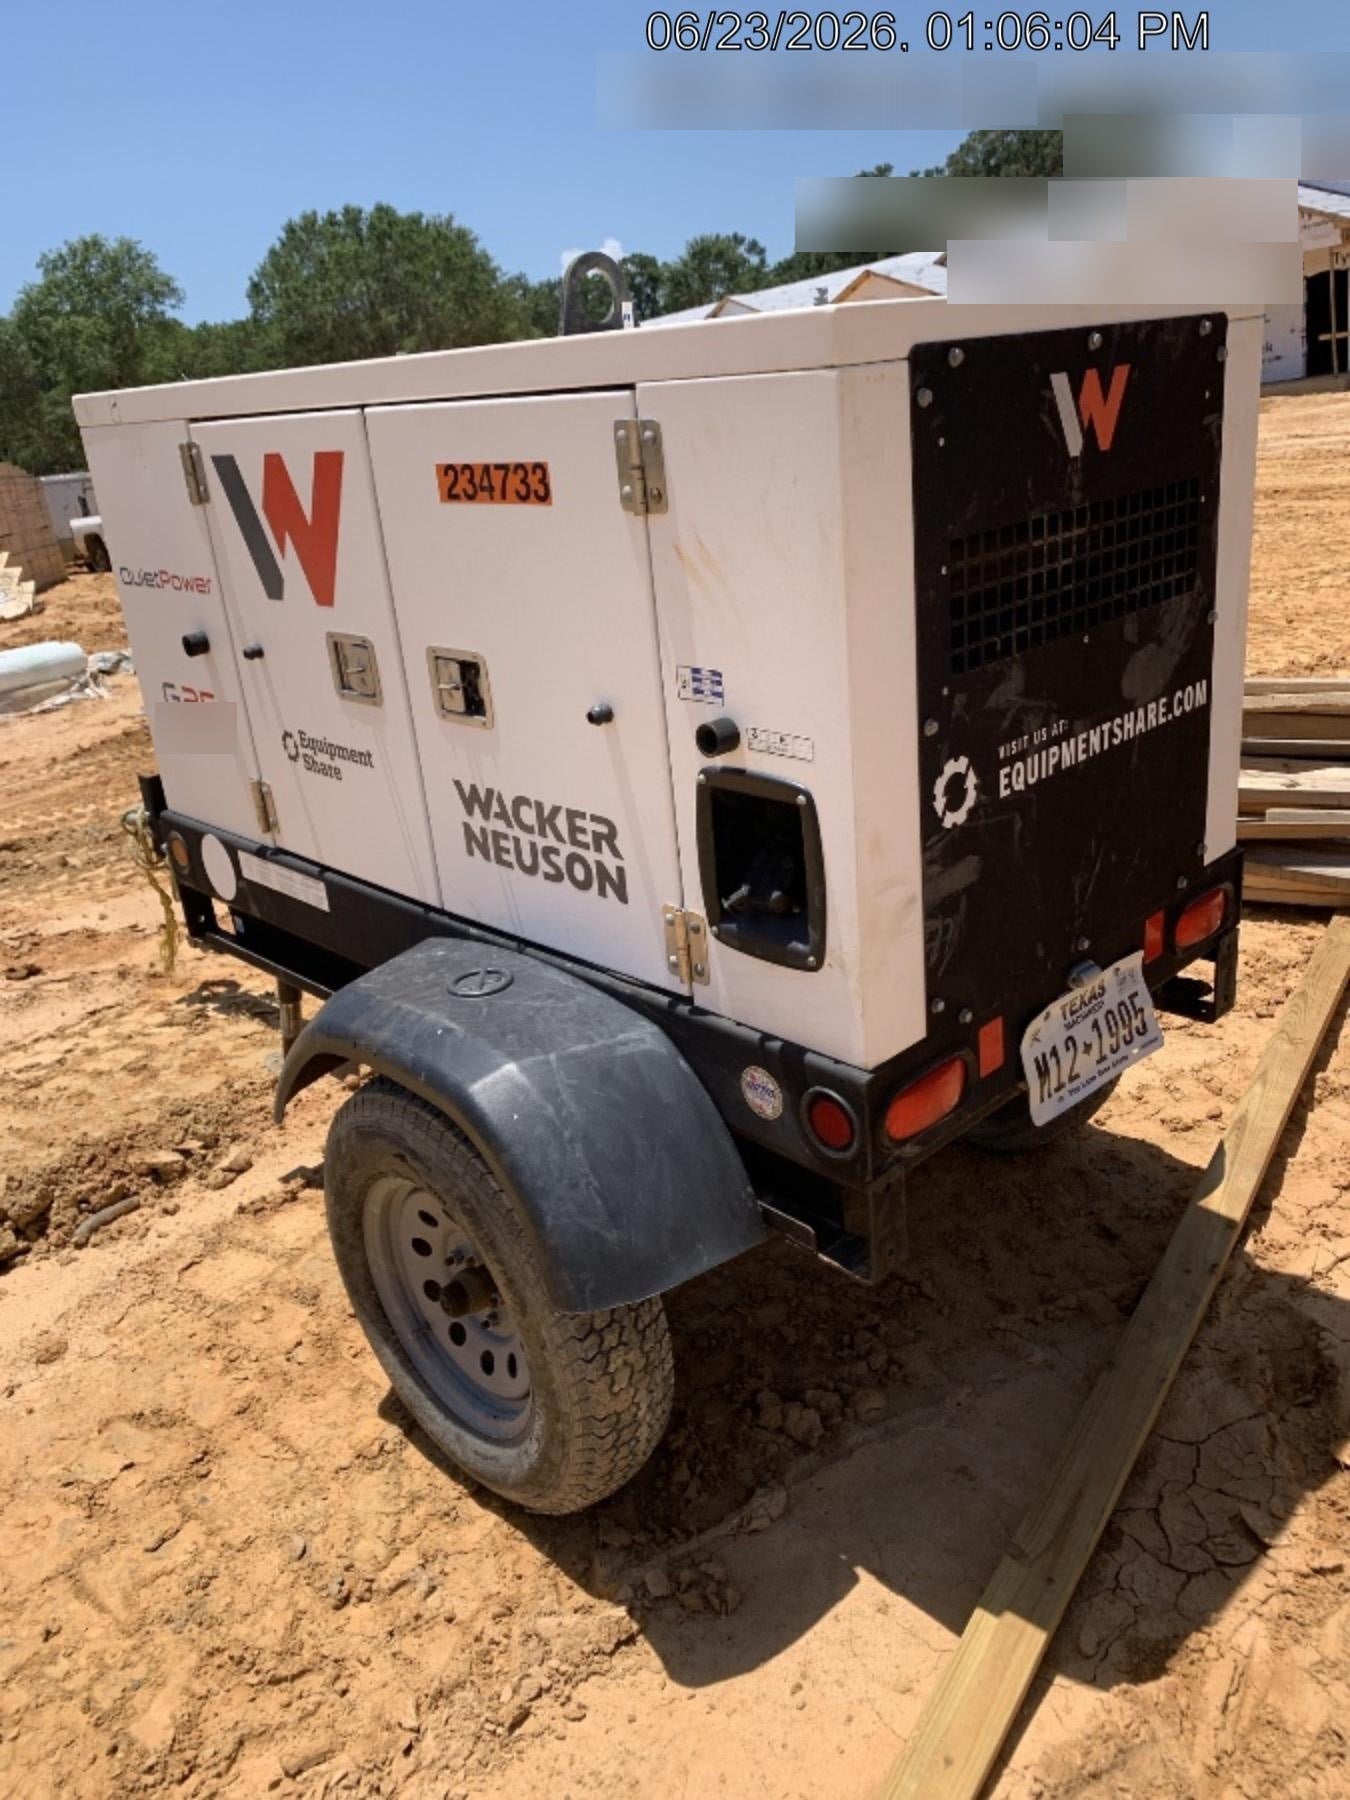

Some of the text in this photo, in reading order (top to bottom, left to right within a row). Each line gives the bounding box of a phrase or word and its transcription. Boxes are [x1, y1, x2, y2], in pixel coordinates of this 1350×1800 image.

[443, 462, 551, 502] 234733
[298, 729, 375, 769] Equipment
[998, 719, 1069, 759] VISIT US AT:
[999, 679, 1207, 798] EQUIPMENTSHARE.COM
[302, 753, 343, 781] Share
[452, 778, 625, 861] WACKER
[462, 821, 629, 904] NEUSON
[1060, 978, 1106, 1021] TEXAS
